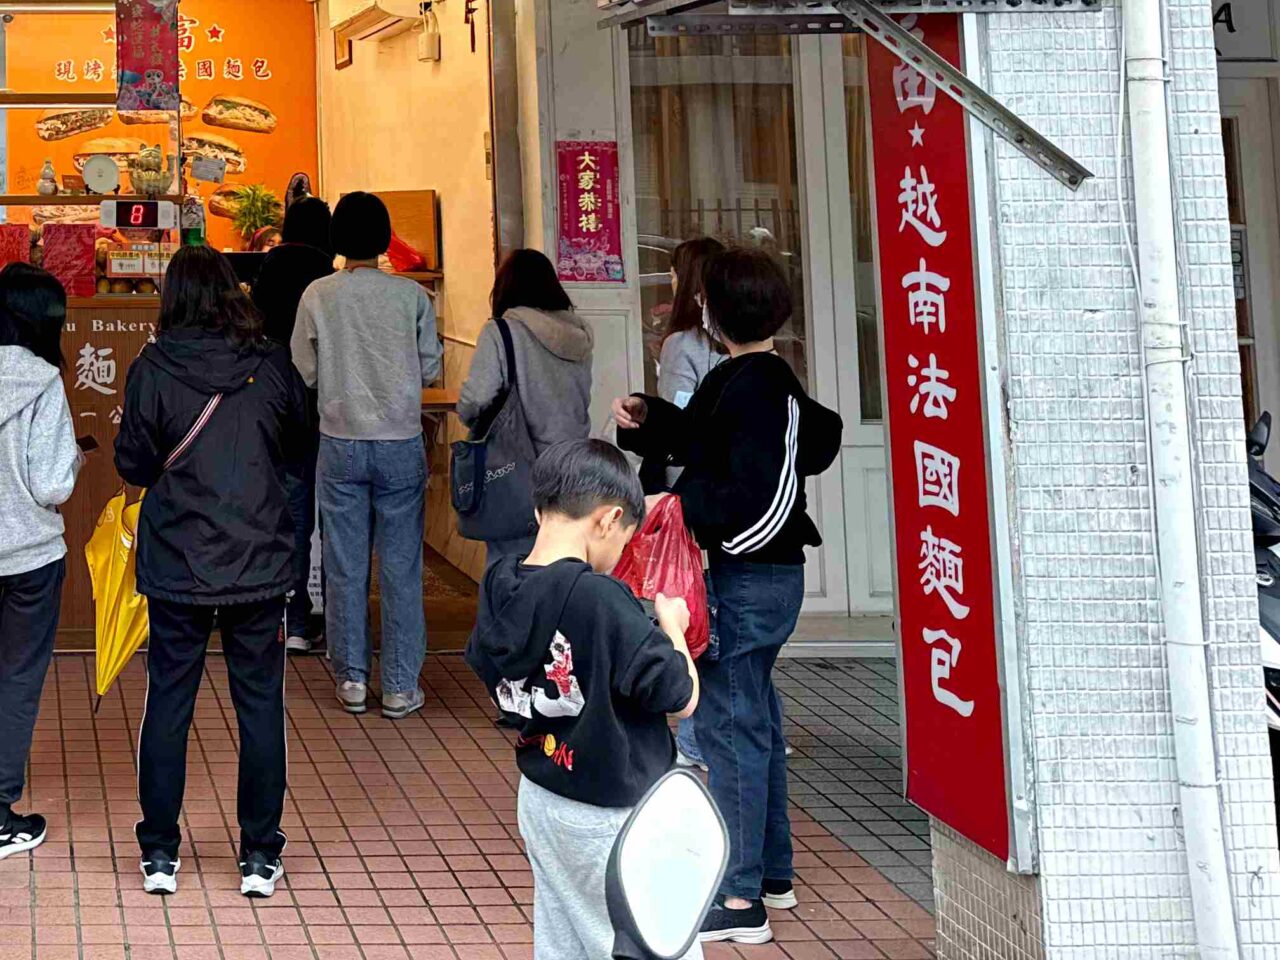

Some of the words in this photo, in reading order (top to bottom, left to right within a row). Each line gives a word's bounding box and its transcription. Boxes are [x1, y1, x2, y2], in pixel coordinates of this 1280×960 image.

[130, 205, 144, 224] 8
[897, 164, 975, 718] 越南法國麵包
